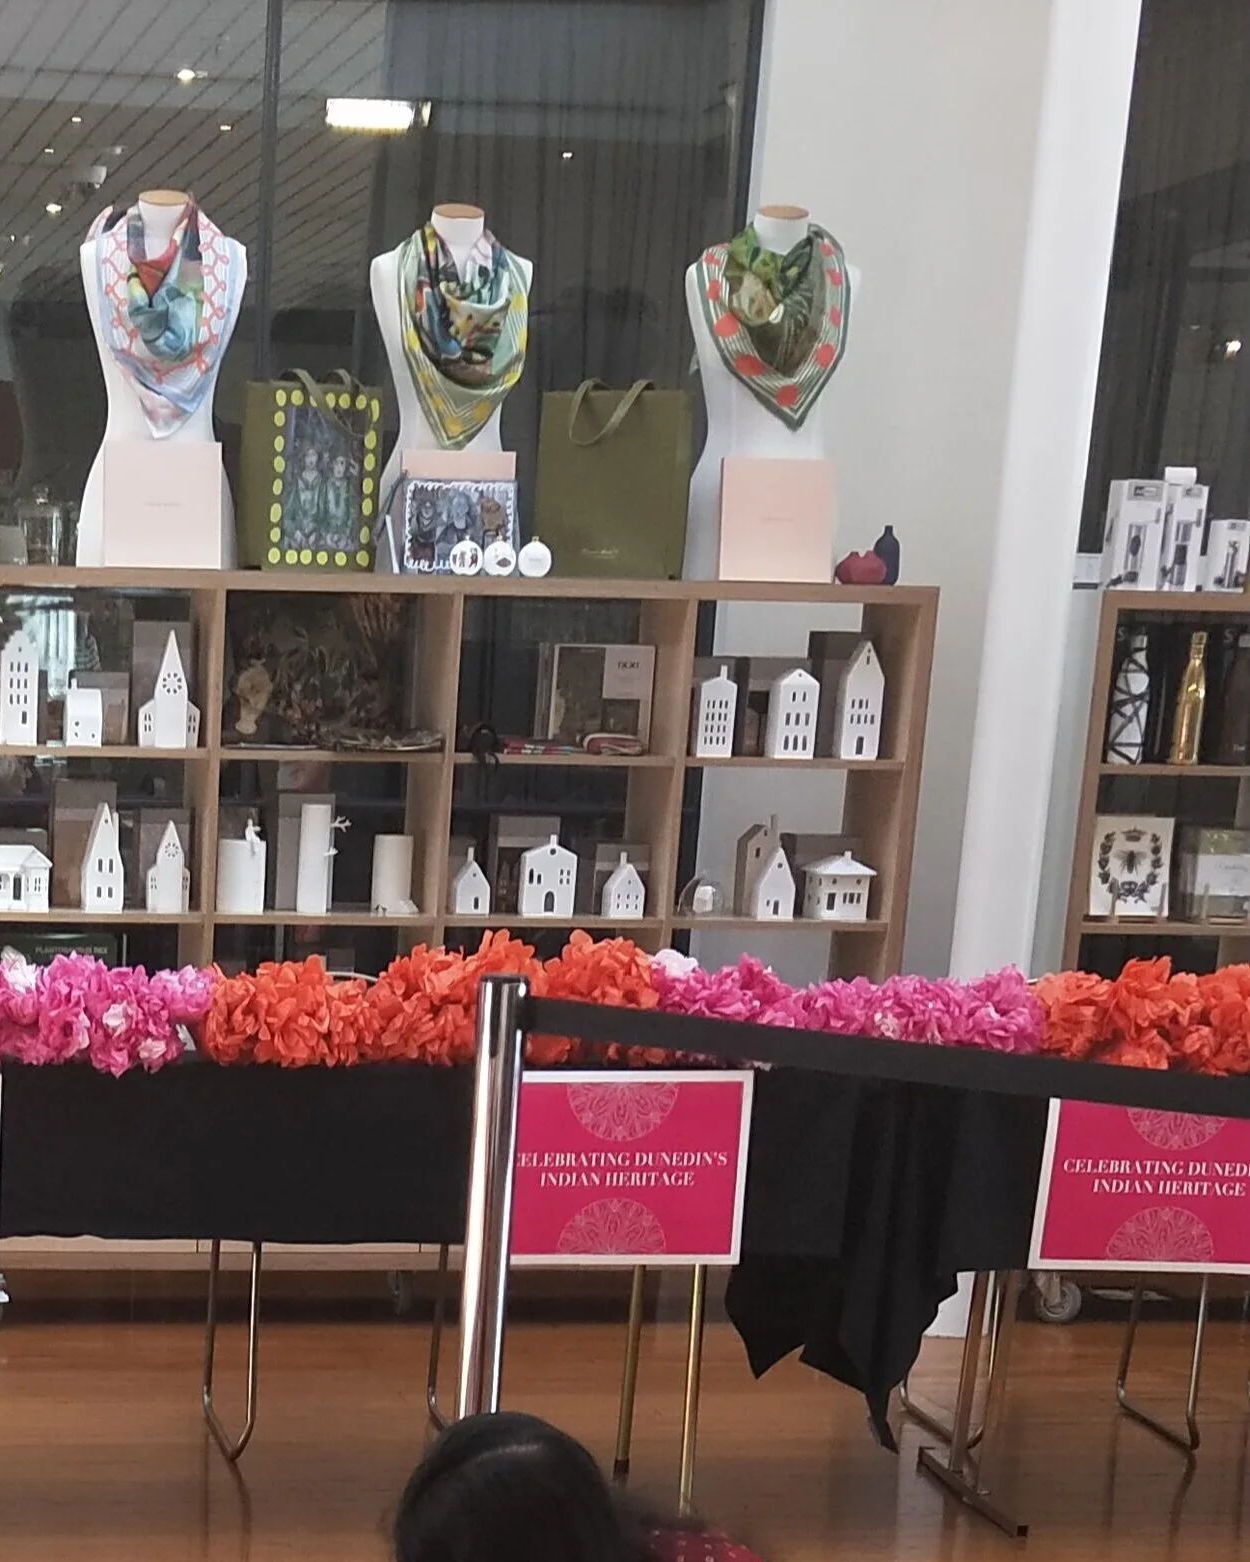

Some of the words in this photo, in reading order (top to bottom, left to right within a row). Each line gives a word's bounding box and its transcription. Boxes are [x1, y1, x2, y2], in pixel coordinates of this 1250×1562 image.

[635, 1151, 728, 1166] DUNEDIN'S
[1063, 1158, 1184, 1176] CELEBRATING
[540, 1171, 600, 1188] INDIAN
[605, 1171, 695, 1188] HERITAGE
[1092, 1178, 1154, 1195] INDIAN
[1158, 1180, 1247, 1198] HERITAGE
